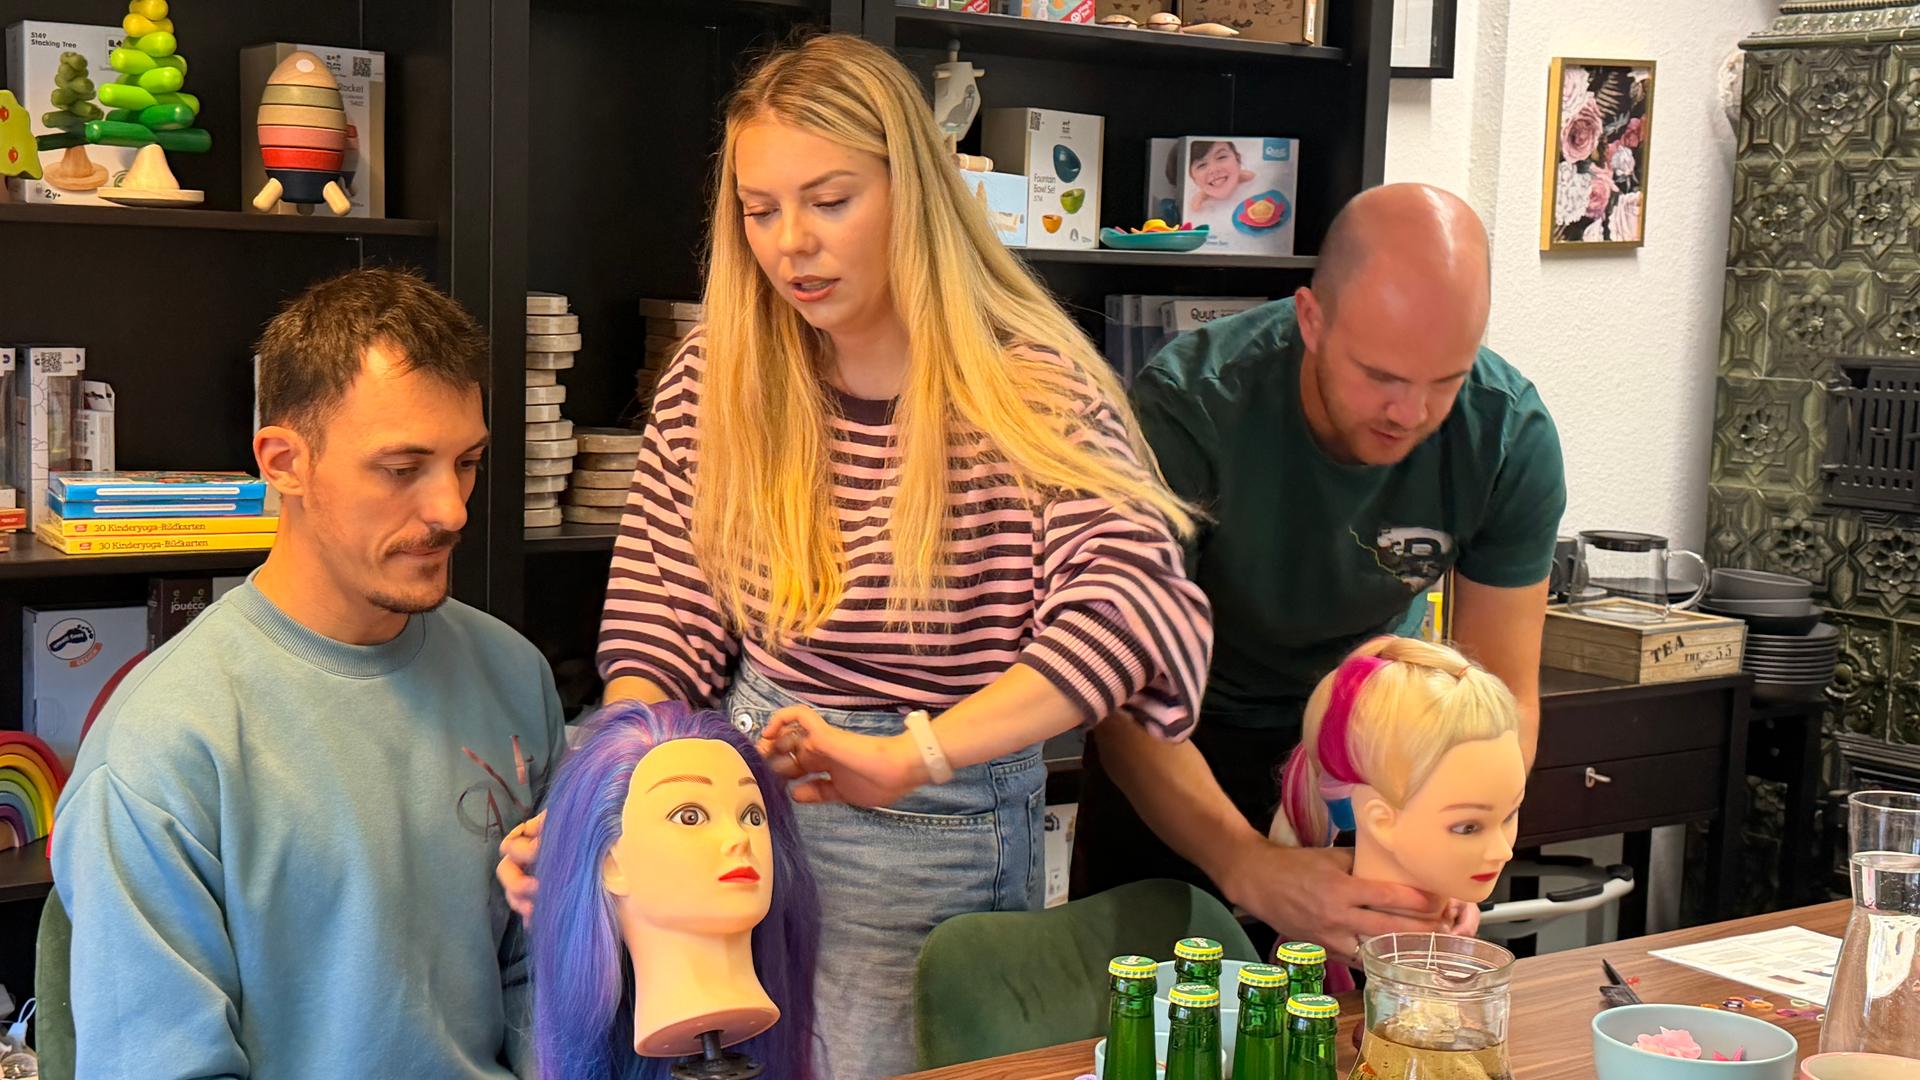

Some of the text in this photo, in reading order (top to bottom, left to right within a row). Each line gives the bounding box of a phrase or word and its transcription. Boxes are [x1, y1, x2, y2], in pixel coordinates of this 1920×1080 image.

[31, 39, 77, 49] Stacking Tree
[1650, 635, 1685, 664] TEA
